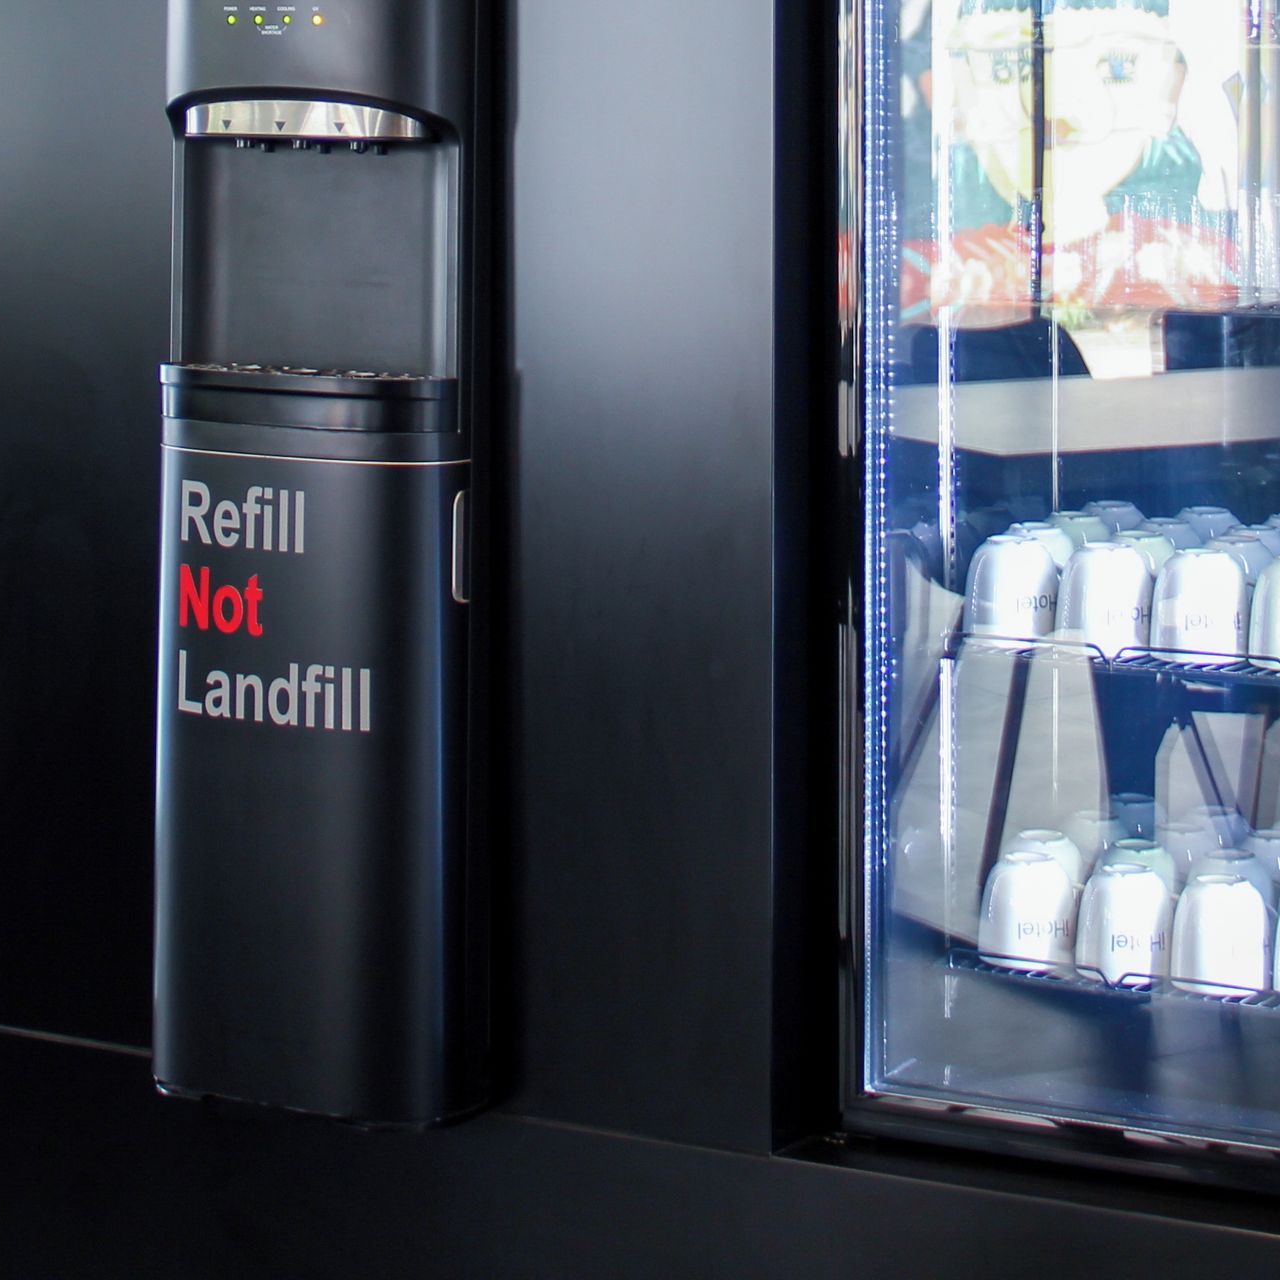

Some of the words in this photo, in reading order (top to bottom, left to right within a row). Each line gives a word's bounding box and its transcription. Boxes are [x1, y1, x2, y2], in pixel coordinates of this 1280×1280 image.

[181, 479, 305, 553] Refill
[179, 563, 263, 637] Not
[178, 649, 371, 732] Landfill
